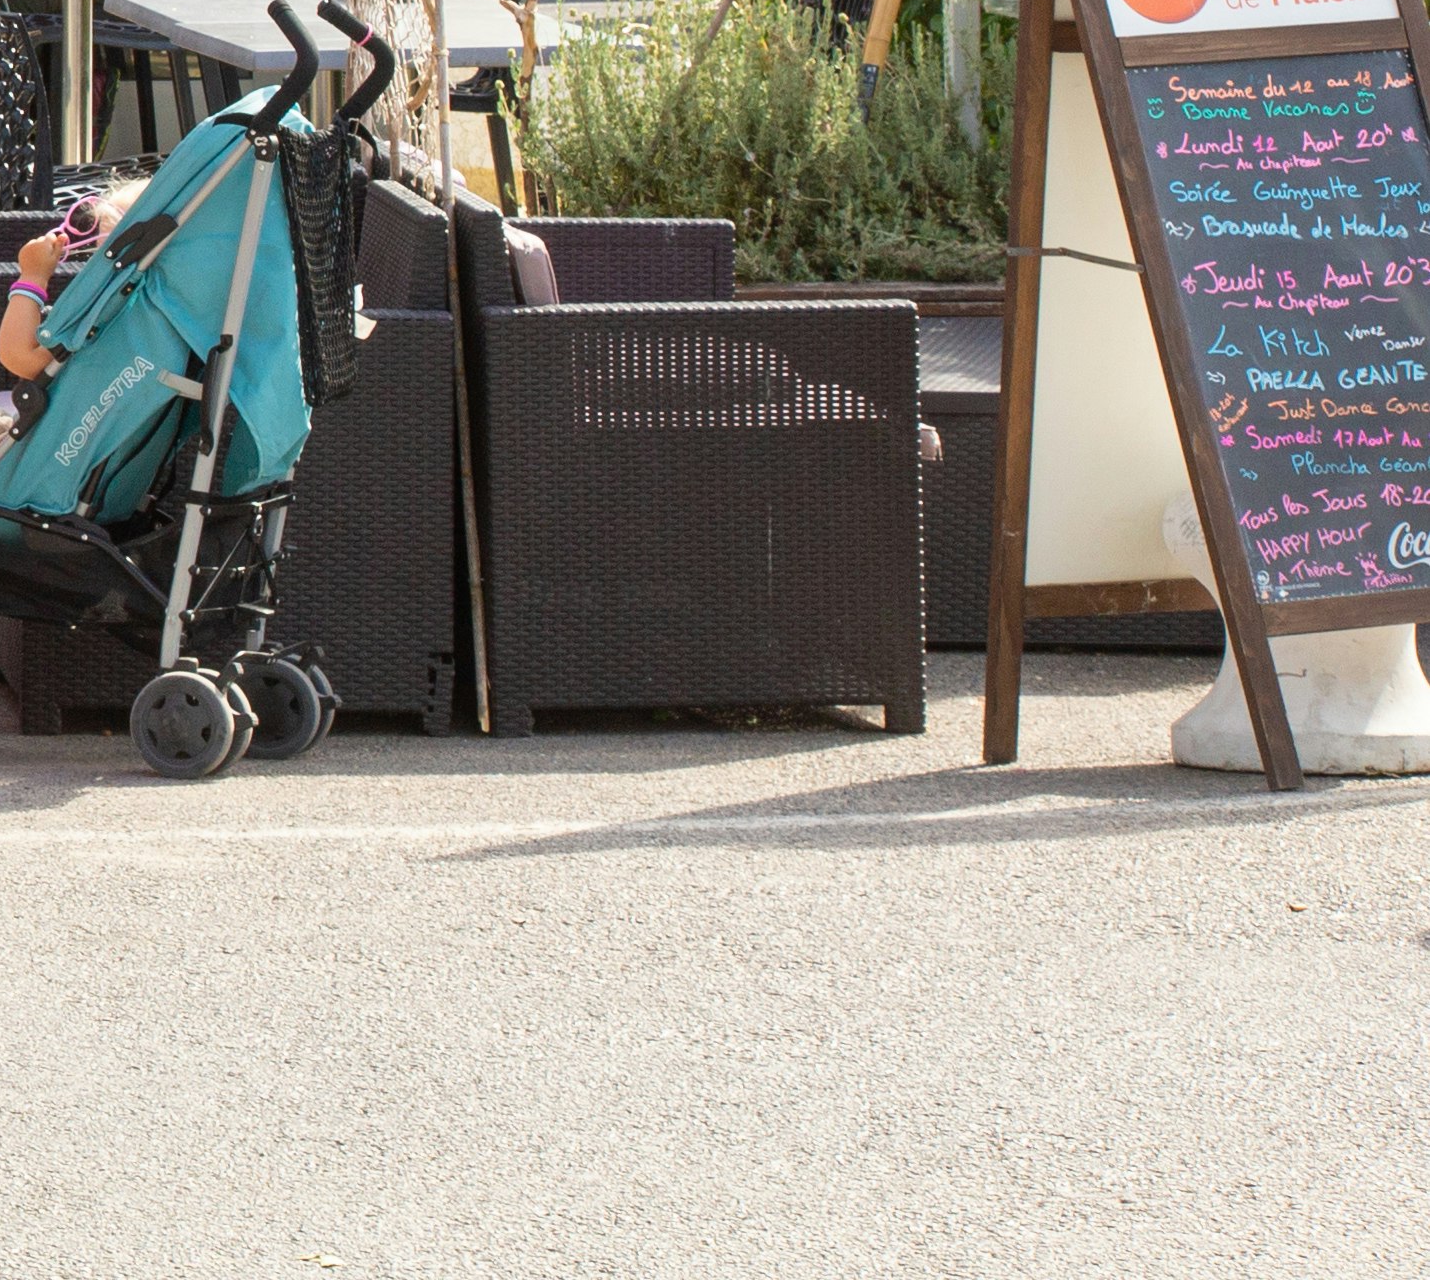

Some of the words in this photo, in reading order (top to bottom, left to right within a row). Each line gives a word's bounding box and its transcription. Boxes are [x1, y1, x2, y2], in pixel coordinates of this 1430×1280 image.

[1168, 76, 1257, 102] Semaine
[1263, 74, 1286, 98] du
[1289, 80, 1315, 94] 12
[1327, 77, 1350, 88] au
[1354, 70, 1372, 86] 18
[1182, 102, 1252, 121] Bonne
[1174, 129, 1245, 155] Lundi
[1252, 136, 1278, 153] 12
[1302, 128, 1344, 153] Aout
[1236, 157, 1254, 170] Au
[1169, 181, 1237, 203] Soirée
[1253, 176, 1362, 210] Guinguette
[1374, 177, 1422, 199] Jeux
[1202, 212, 1303, 239] Brasucade
[1311, 216, 1332, 239] de
[1341, 213, 1409, 240] Moules
[1193, 261, 1265, 294] Jeudi
[1276, 271, 1296, 289] 15
[1324, 260, 1374, 289] Aout
[1254, 295, 1274, 309] Au
[1208, 325, 1243, 356] La
[1258, 325, 1331, 357] Kitch
[1344, 324, 1386, 342] Venez
[1382, 336, 1425, 352] Danser
[1246, 367, 1325, 392] PAELLA
[1338, 360, 1428, 390] GEANTE
[55, 356, 155, 466] KOELSTRA
[1268, 399, 1316, 420] Just
[1321, 398, 1378, 417] Dance
[1245, 425, 1323, 449] Samedi
[1333, 429, 1353, 449] 17
[1357, 427, 1394, 447] Aout
[1401, 431, 1422, 448] Au
[1290, 451, 1372, 475] Plancha
[1240, 507, 1278, 530] Tous
[1282, 494, 1310, 516] les
[1312, 488, 1368, 513] Jours
[1256, 531, 1310, 565] HAPPY
[1278, 572, 1289, 585] A
[1291, 558, 1352, 580] Thème
